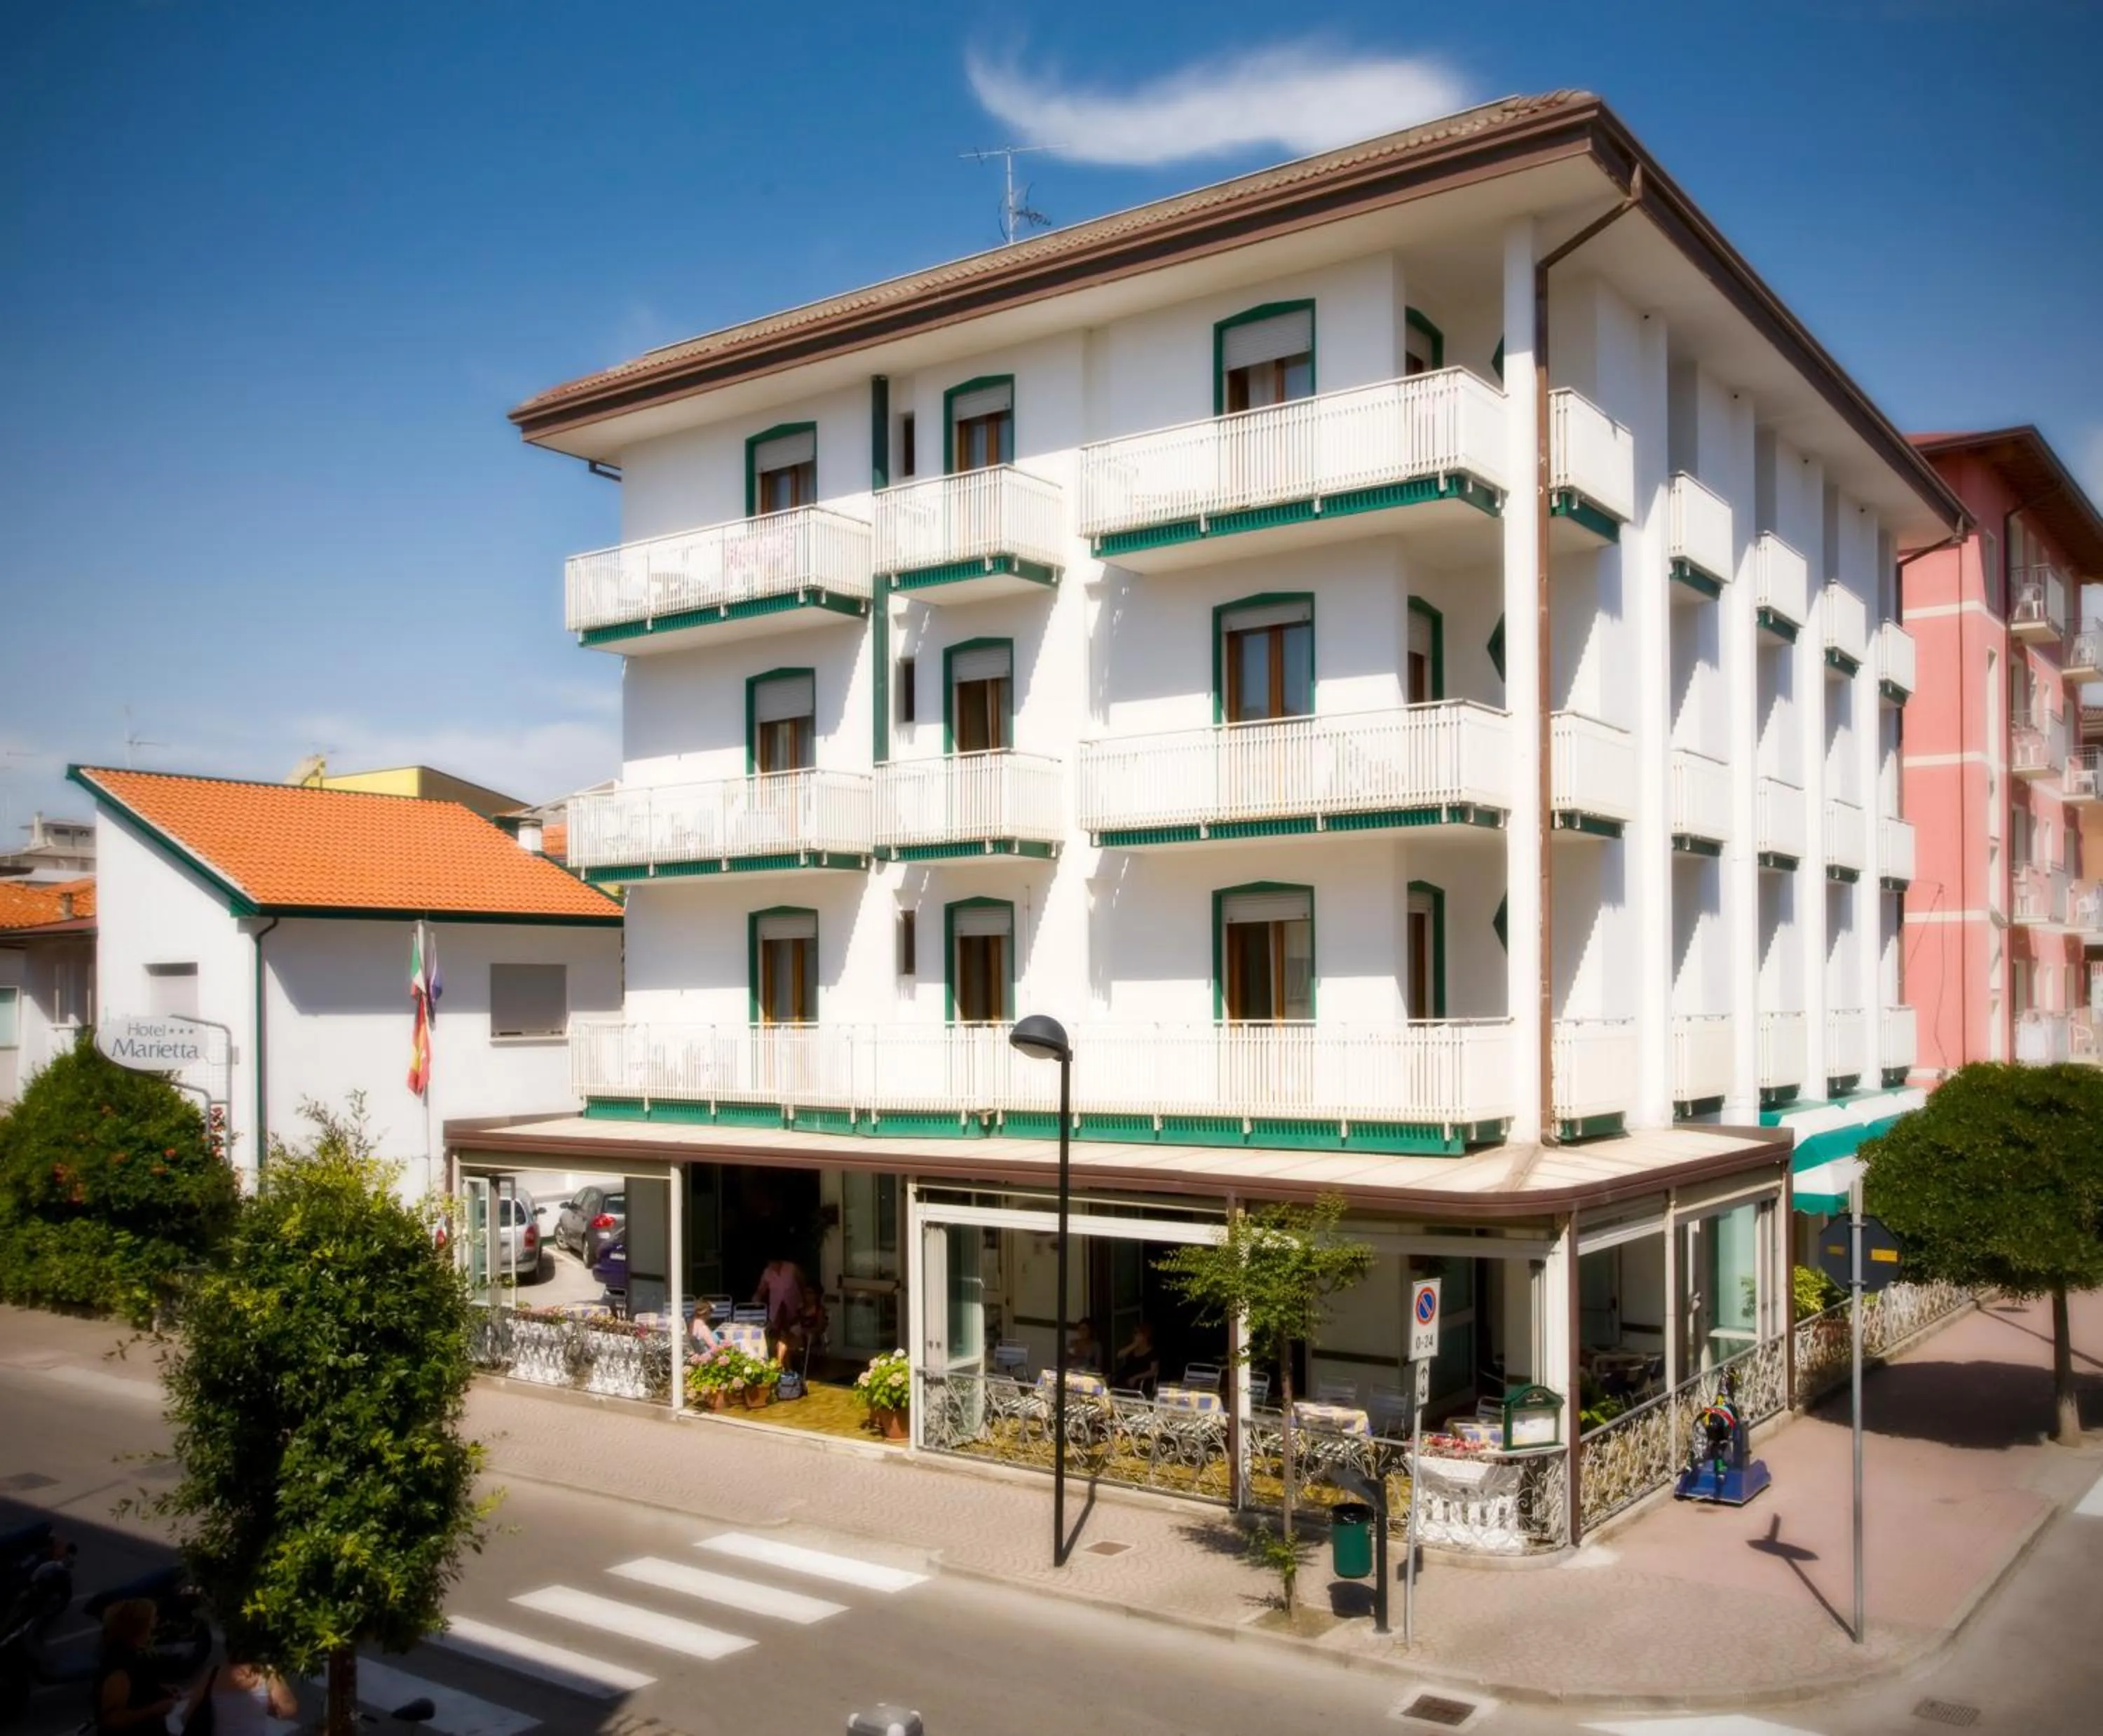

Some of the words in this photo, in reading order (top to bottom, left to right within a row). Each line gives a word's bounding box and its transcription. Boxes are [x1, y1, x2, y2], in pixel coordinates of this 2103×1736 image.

[128, 1022, 166, 1037] Hotel
[112, 1039, 198, 1058] Marietta
[1416, 1334, 1433, 1350] 0-24
